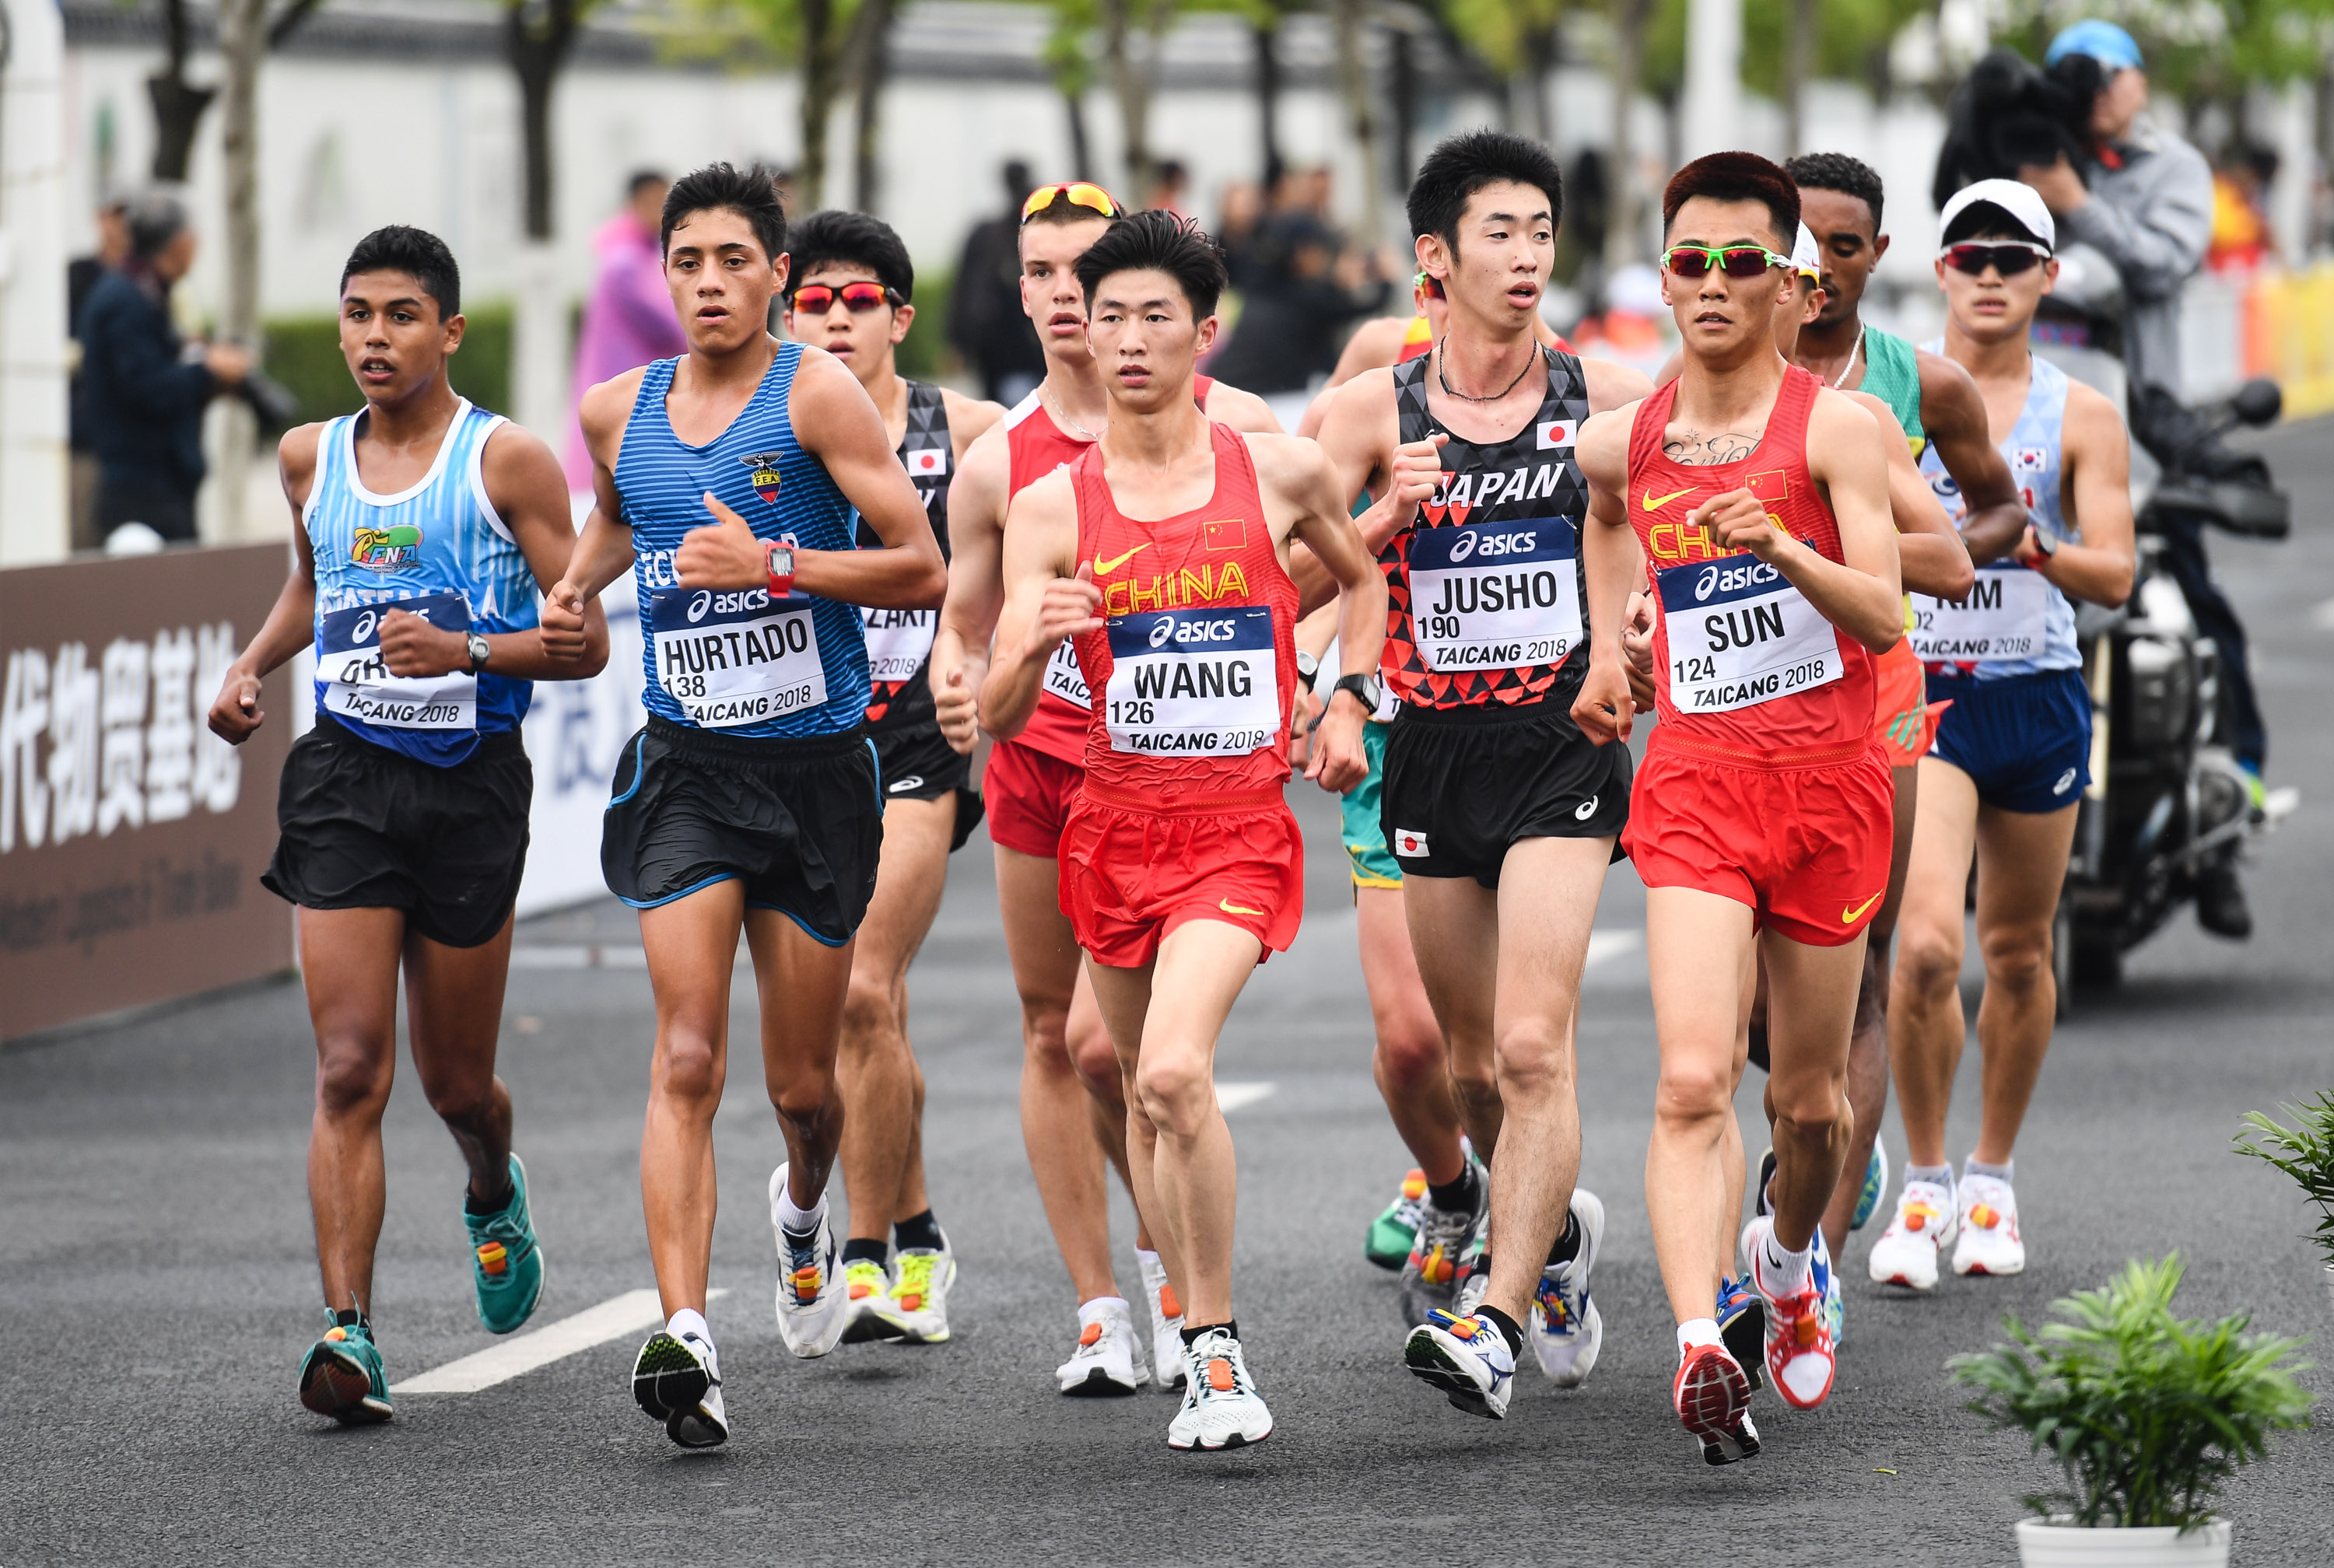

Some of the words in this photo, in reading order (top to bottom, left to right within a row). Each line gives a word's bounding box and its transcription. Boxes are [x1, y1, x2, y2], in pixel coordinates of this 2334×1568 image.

[755, 476, 780, 485] F.E.A.
[1430, 462, 1566, 509] JAPAN
[368, 544, 418, 565] FNA
[1477, 531, 1537, 556] asics
[1105, 561, 1249, 617] CHINA
[1719, 562, 1779, 592] asics
[713, 588, 769, 614] asics
[1432, 570, 1558, 615] JUSHO
[1174, 618, 1236, 643] asics
[1417, 615, 1460, 640] 190
[1705, 601, 1786, 653] SUN
[664, 618, 808, 676] HURTADO
[1435, 643, 1521, 665] TAICANG
[1526, 639, 1567, 659] 2018
[1913, 639, 1990, 655] TAICANG
[1994, 637, 2031, 654] 2018
[878, 657, 916, 674] 2018
[1673, 655, 1716, 683] 124
[663, 675, 706, 698] 138
[1051, 671, 1092, 701] TAIC
[1134, 660, 1253, 699] WANG
[1694, 674, 1779, 707] TAICANG
[1785, 660, 1825, 689] 2018
[345, 692, 415, 723] TACANG
[418, 705, 460, 723] 2018
[774, 684, 811, 712] 2018
[1110, 701, 1155, 725] 126
[1130, 732, 1218, 751] TAICANG
[1222, 730, 1265, 751] 2018
